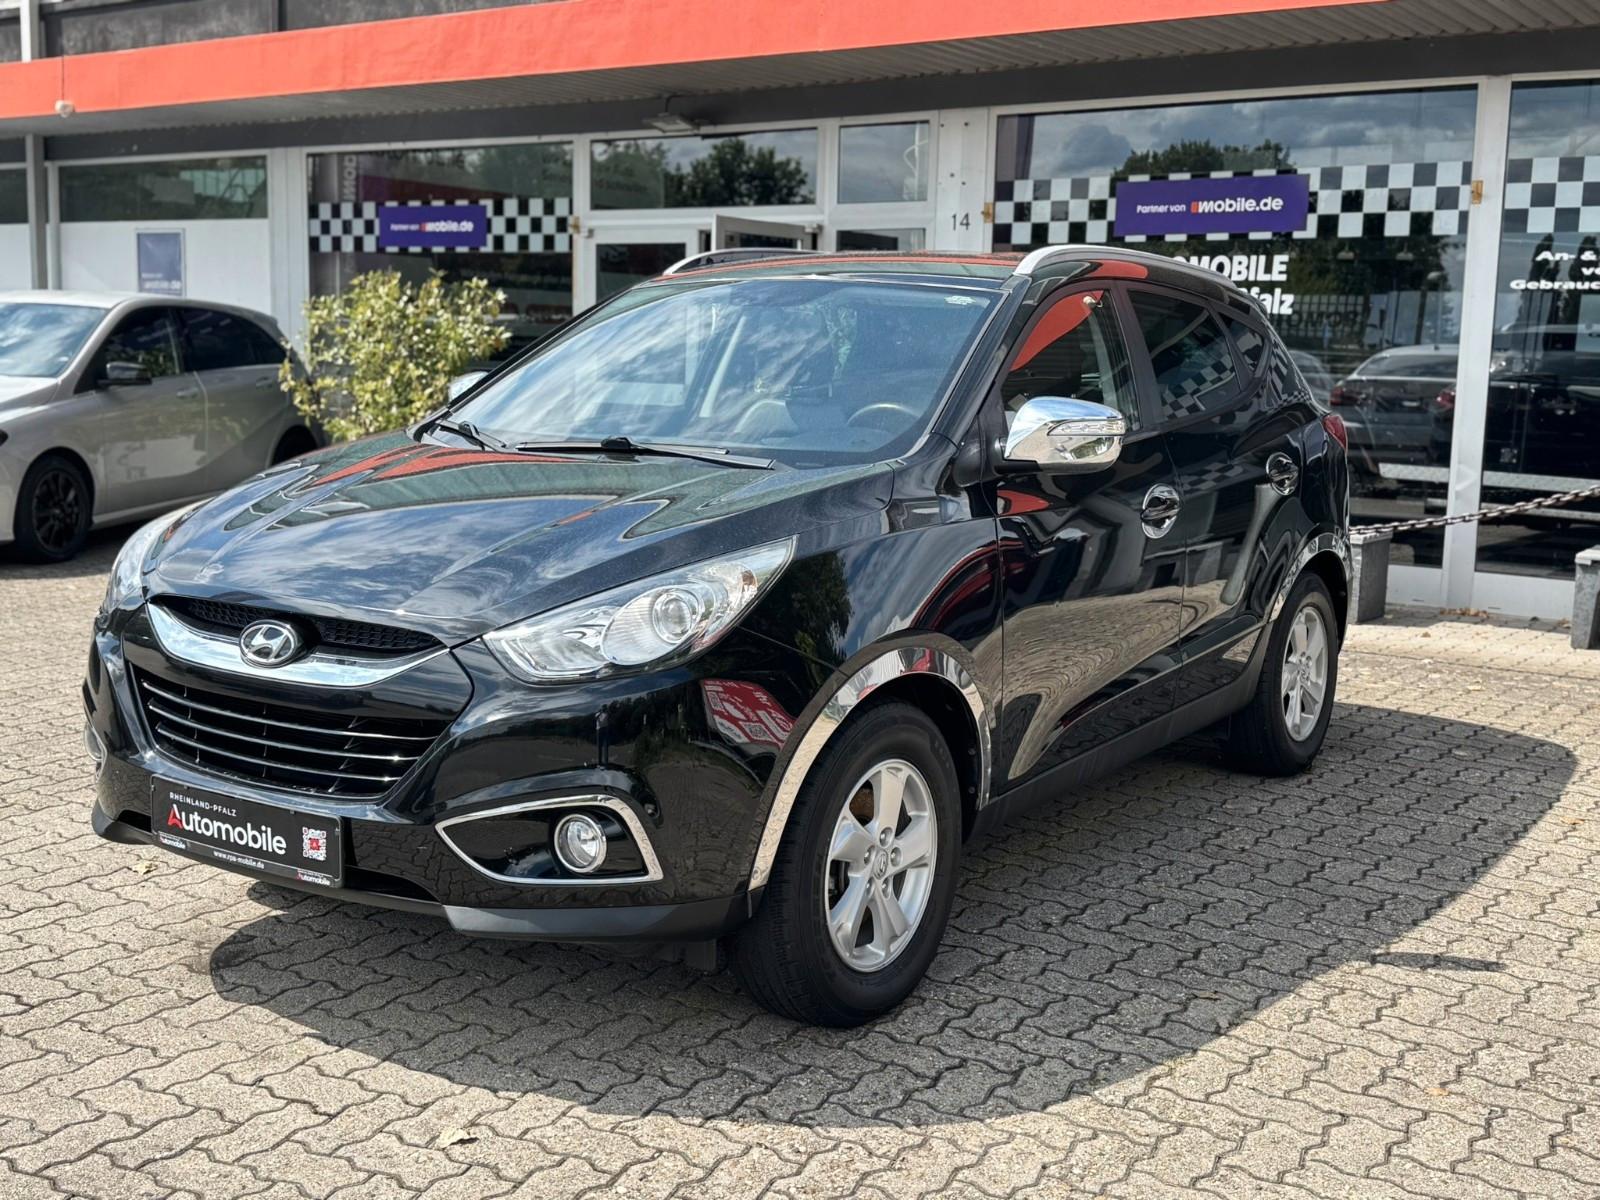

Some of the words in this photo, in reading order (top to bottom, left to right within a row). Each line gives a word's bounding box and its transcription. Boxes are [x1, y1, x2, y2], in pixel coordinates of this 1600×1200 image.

[1136, 204, 1169, 215] Partner
[1169, 203, 1186, 213] von
[1197, 196, 1284, 214] mobile.de
[951, 212, 971, 231] 14
[1535, 250, 1576, 261] An-
[1580, 250, 1597, 261] &
[1173, 254, 1289, 281] OBILE
[169, 791, 237, 817] RHEINLAND-PFALZ
[167, 803, 287, 855] Automobile
